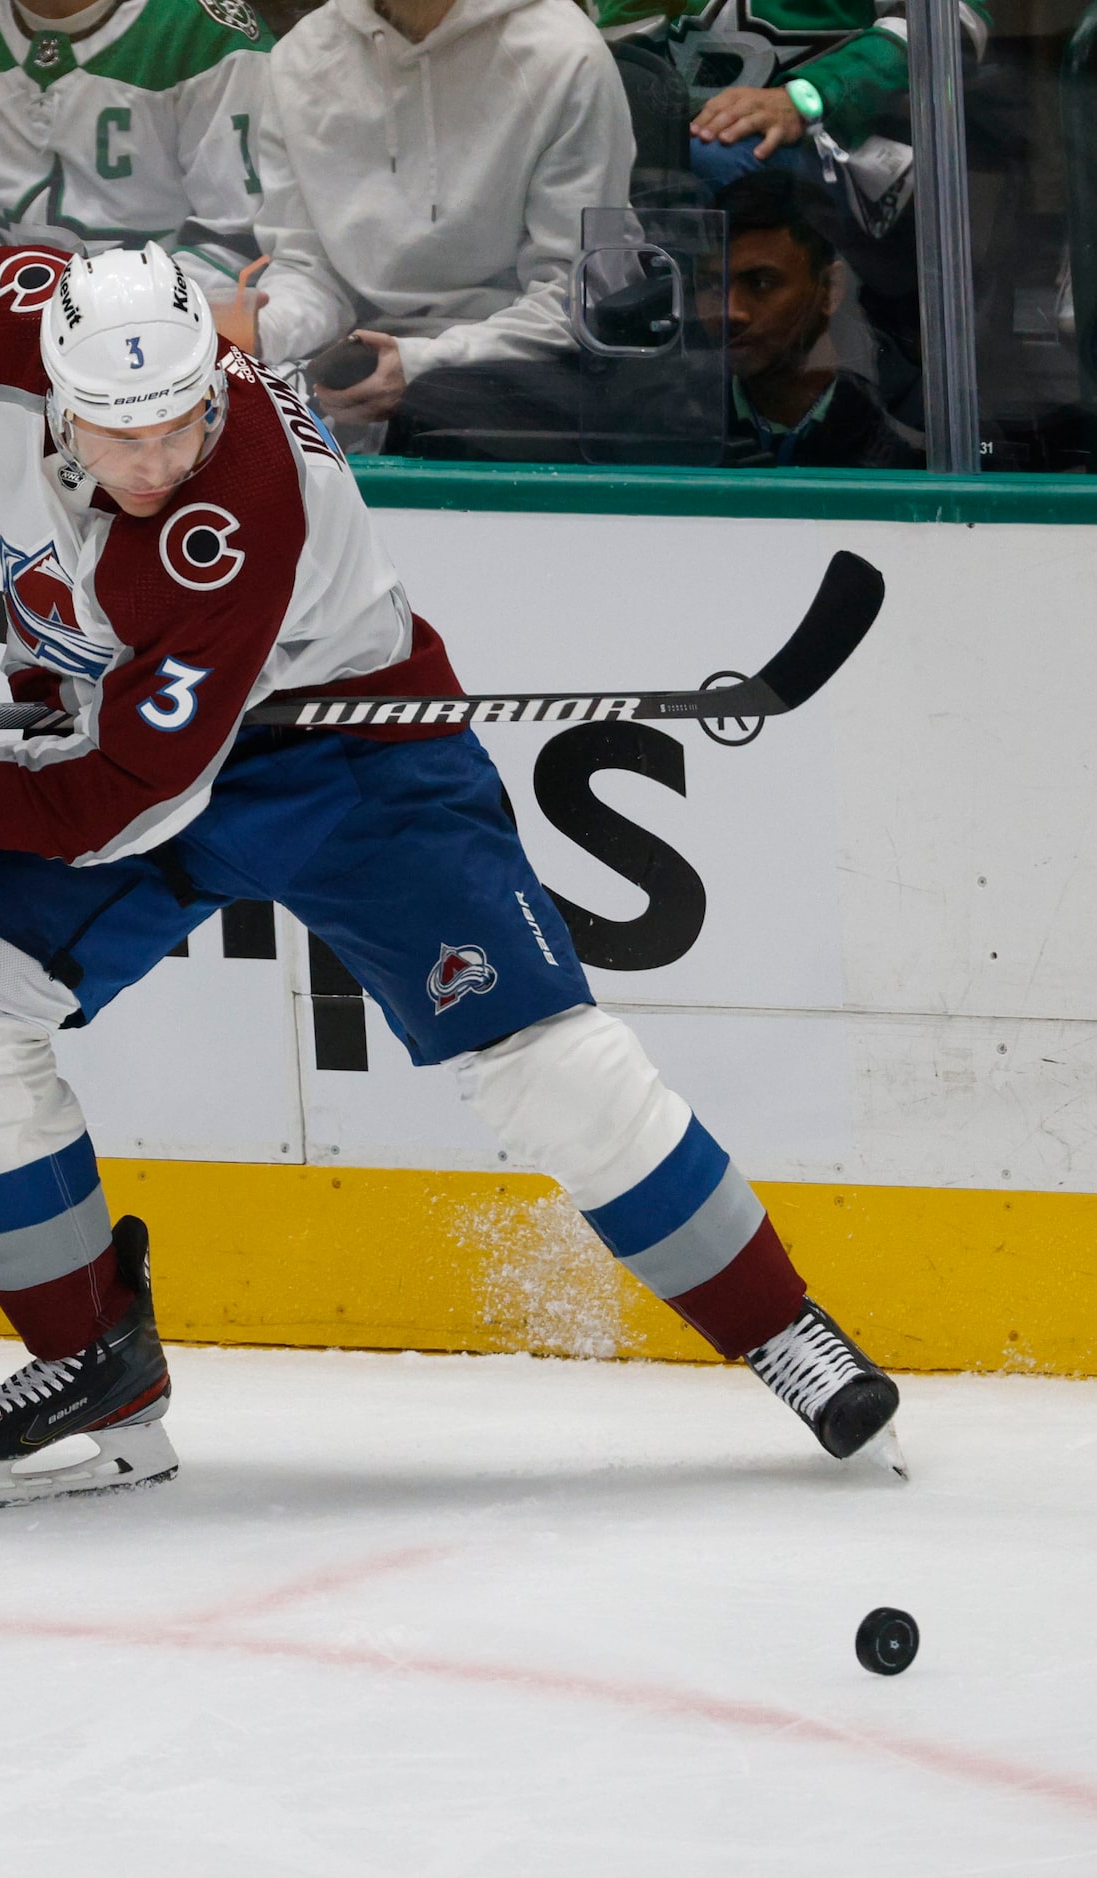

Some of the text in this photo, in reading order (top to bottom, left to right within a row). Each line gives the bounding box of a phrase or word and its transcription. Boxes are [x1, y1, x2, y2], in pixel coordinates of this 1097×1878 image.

[96, 107, 132, 179] C
[126, 336, 145, 370] 3
[230, 345, 256, 384] adidas
[979, 441, 994, 455] 31
[61, 470, 81, 482] NHL
[136, 655, 215, 732] 3
[295, 697, 641, 725] WARRIOR
